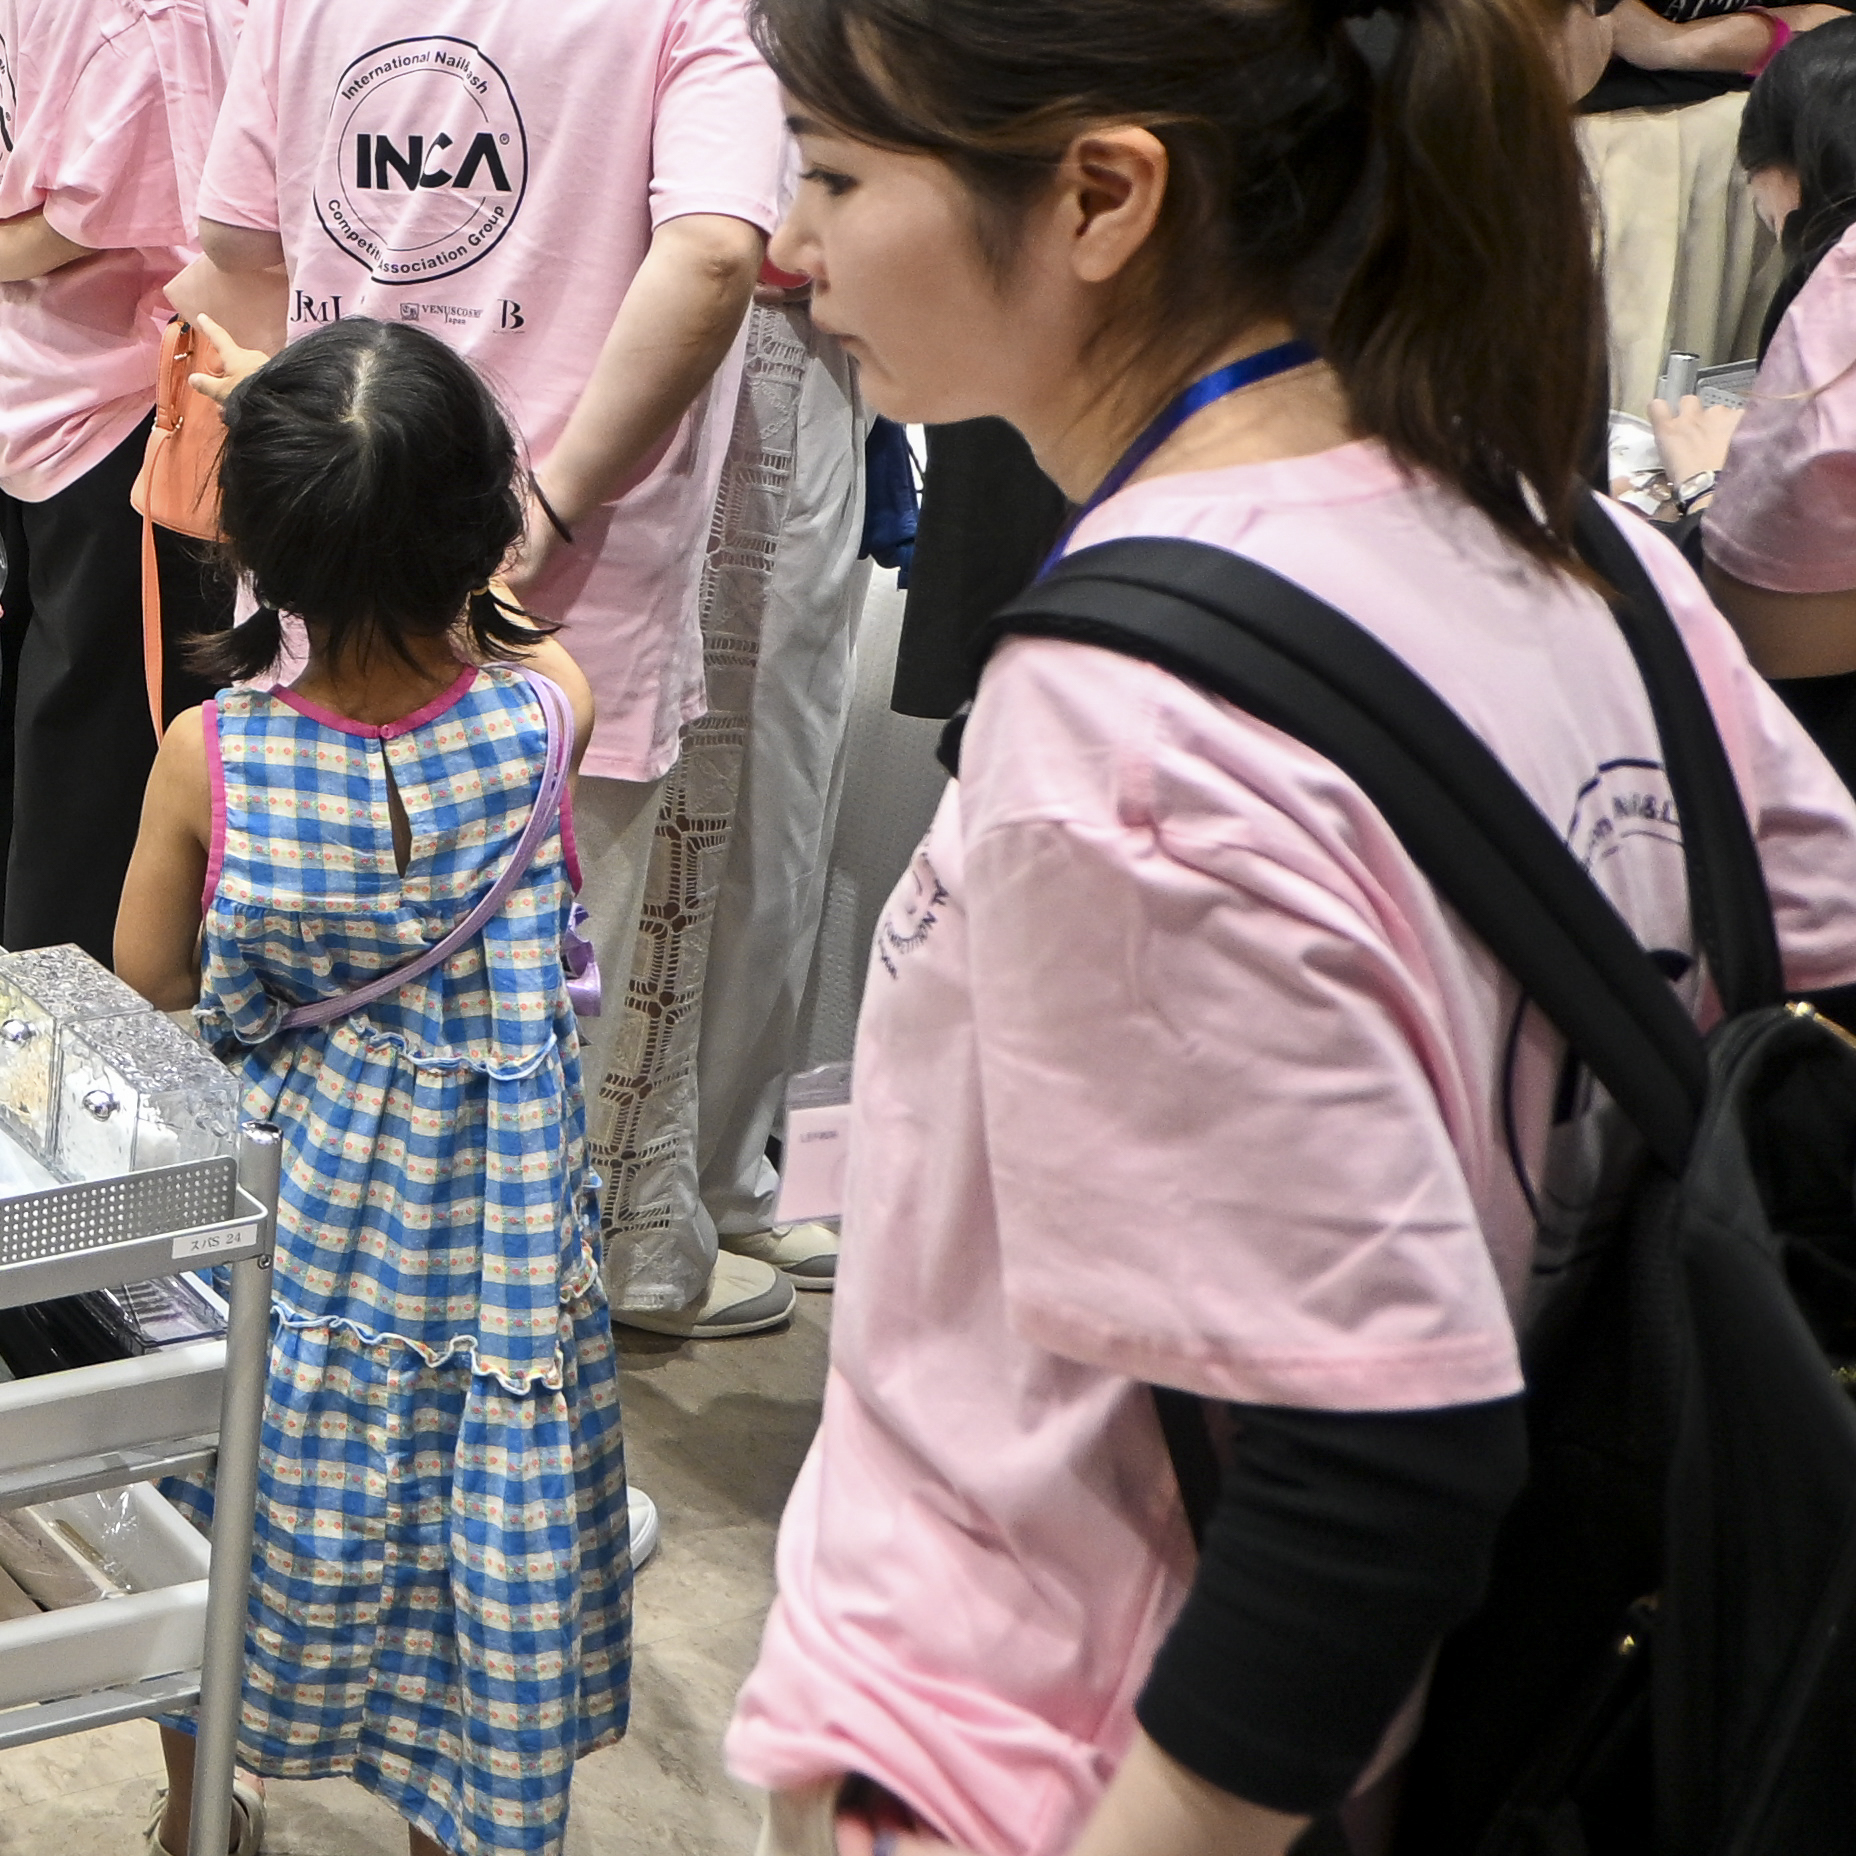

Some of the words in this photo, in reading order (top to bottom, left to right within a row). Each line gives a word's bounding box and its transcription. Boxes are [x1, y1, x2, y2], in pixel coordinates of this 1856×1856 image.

[341, 51, 431, 101] International
[356, 132, 512, 193] INCA
[467, 205, 507, 247] Group
[226, 1232, 242, 1245] 24
